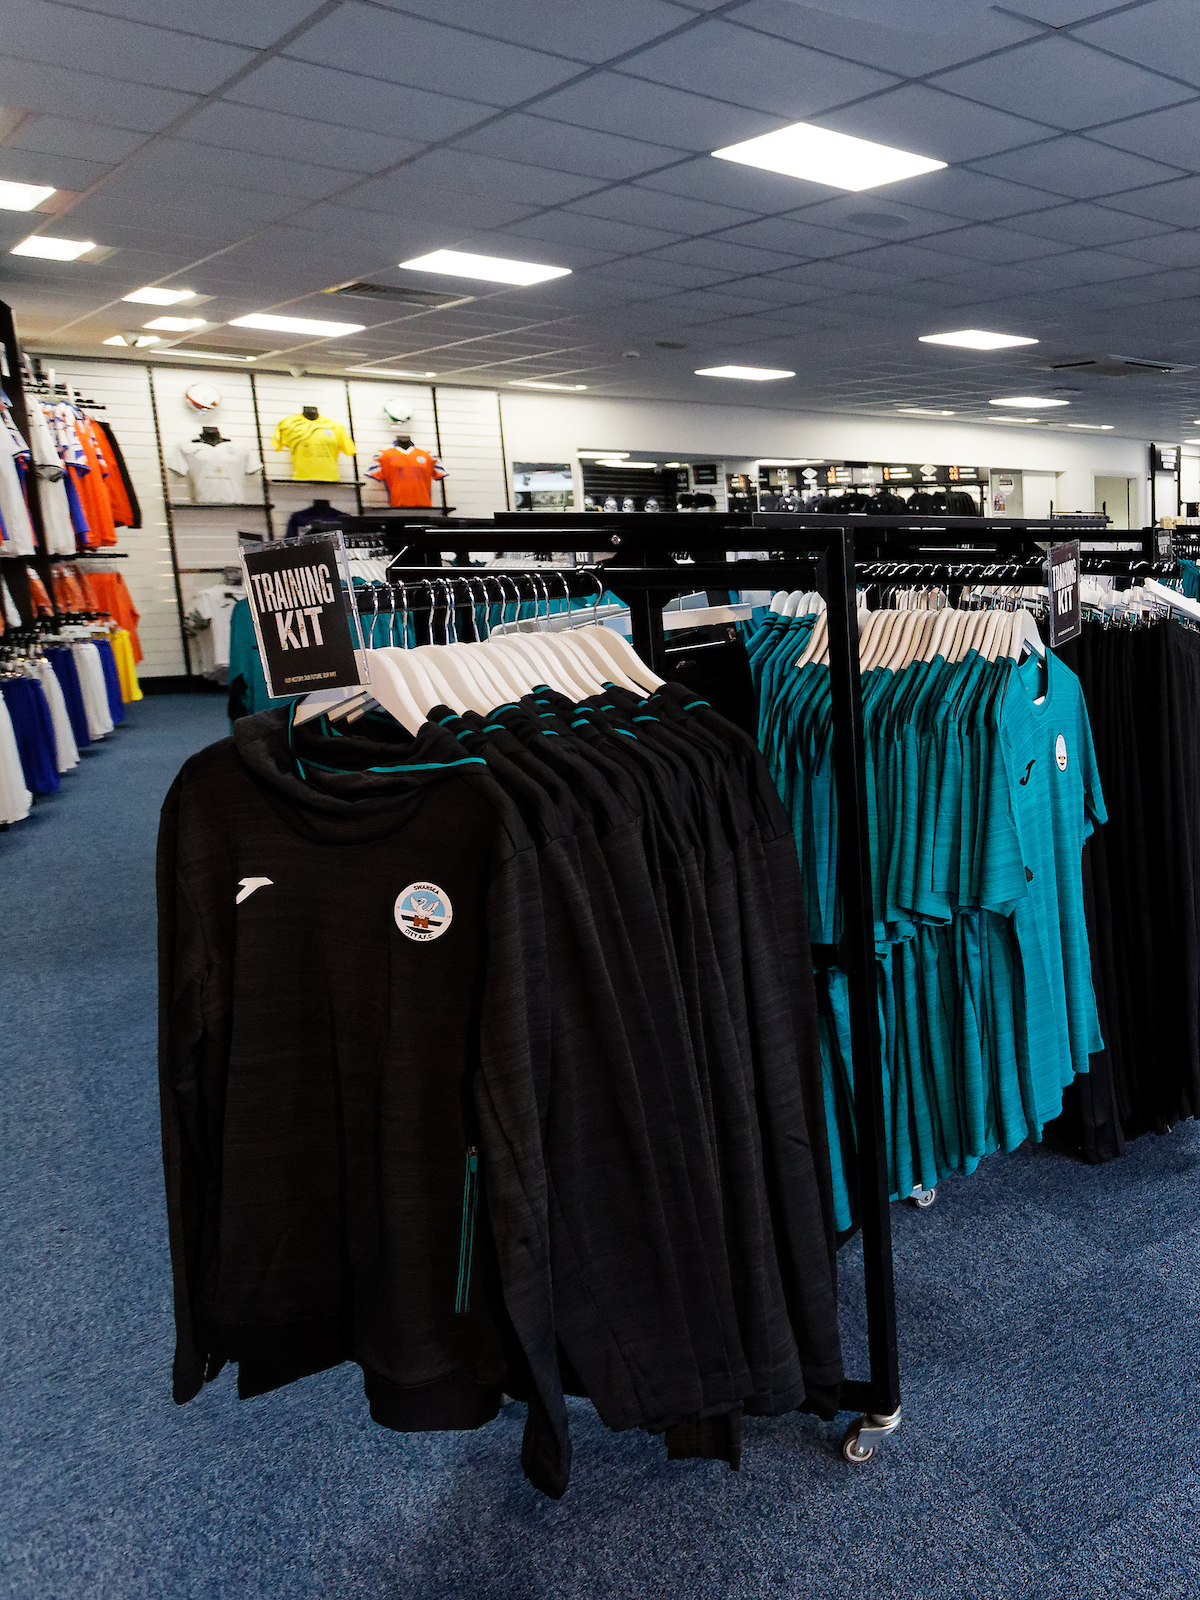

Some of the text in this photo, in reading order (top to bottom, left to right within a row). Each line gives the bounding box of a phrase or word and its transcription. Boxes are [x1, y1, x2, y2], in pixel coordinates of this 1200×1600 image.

[251, 563, 336, 613] TRAINING
[1057, 584, 1074, 616] KIT
[274, 606, 324, 651] KIT
[413, 885, 440, 895] SWANSEA
[404, 928, 418, 938] CITY
